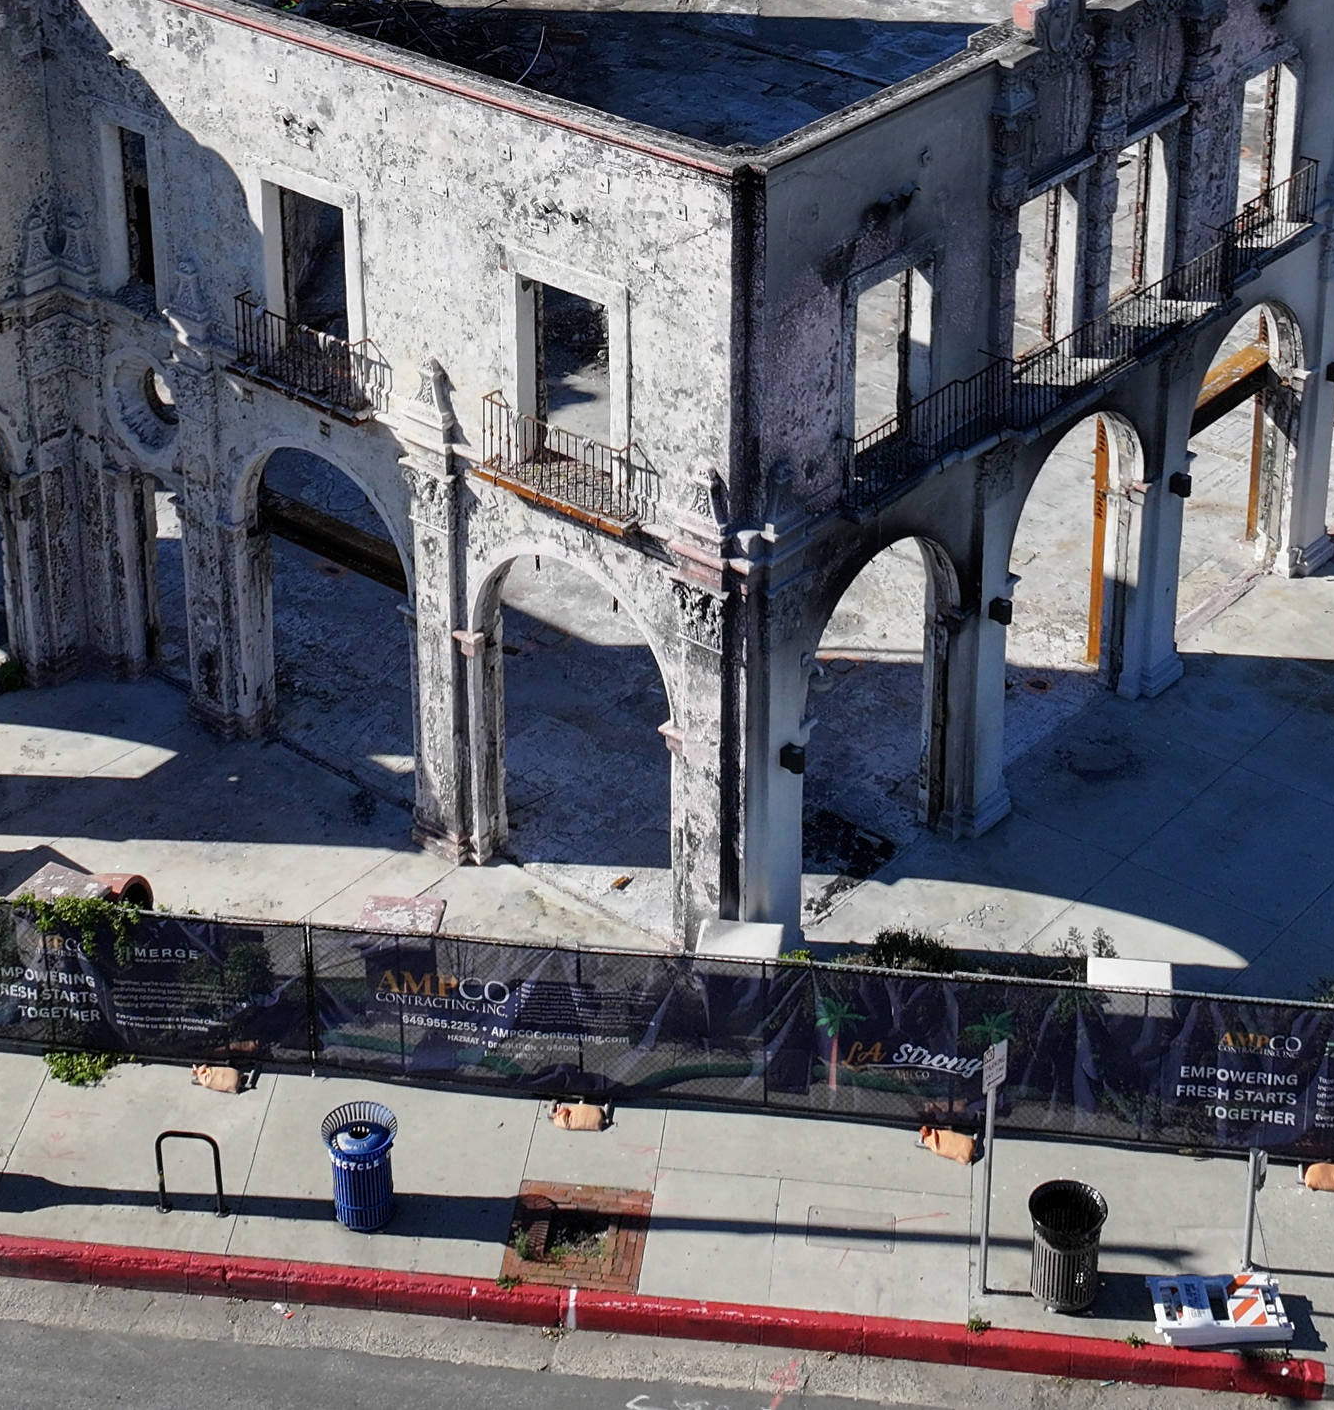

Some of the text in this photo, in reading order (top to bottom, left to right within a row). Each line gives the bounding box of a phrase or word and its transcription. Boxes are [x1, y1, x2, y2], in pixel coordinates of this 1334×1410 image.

[133, 946, 200, 961] MERGE
[42, 988, 99, 1004] STARTS
[377, 968, 510, 1005] AMPCO
[375, 991, 480, 1013] CONTRACTING,
[18, 1004, 101, 1023] TOGETHER
[402, 1014, 630, 1045] 949.955.2255 AMPCOContracting.com
[447, 1033, 480, 1046] HAZMAT
[1220, 1031, 1302, 1053] AMPCO
[841, 1041, 984, 1078] LA Strong
[1180, 1065, 1298, 1086] EMPOWERING
[1176, 1084, 1297, 1106] FRESH STARTS
[1205, 1104, 1296, 1126] TOGETHER
